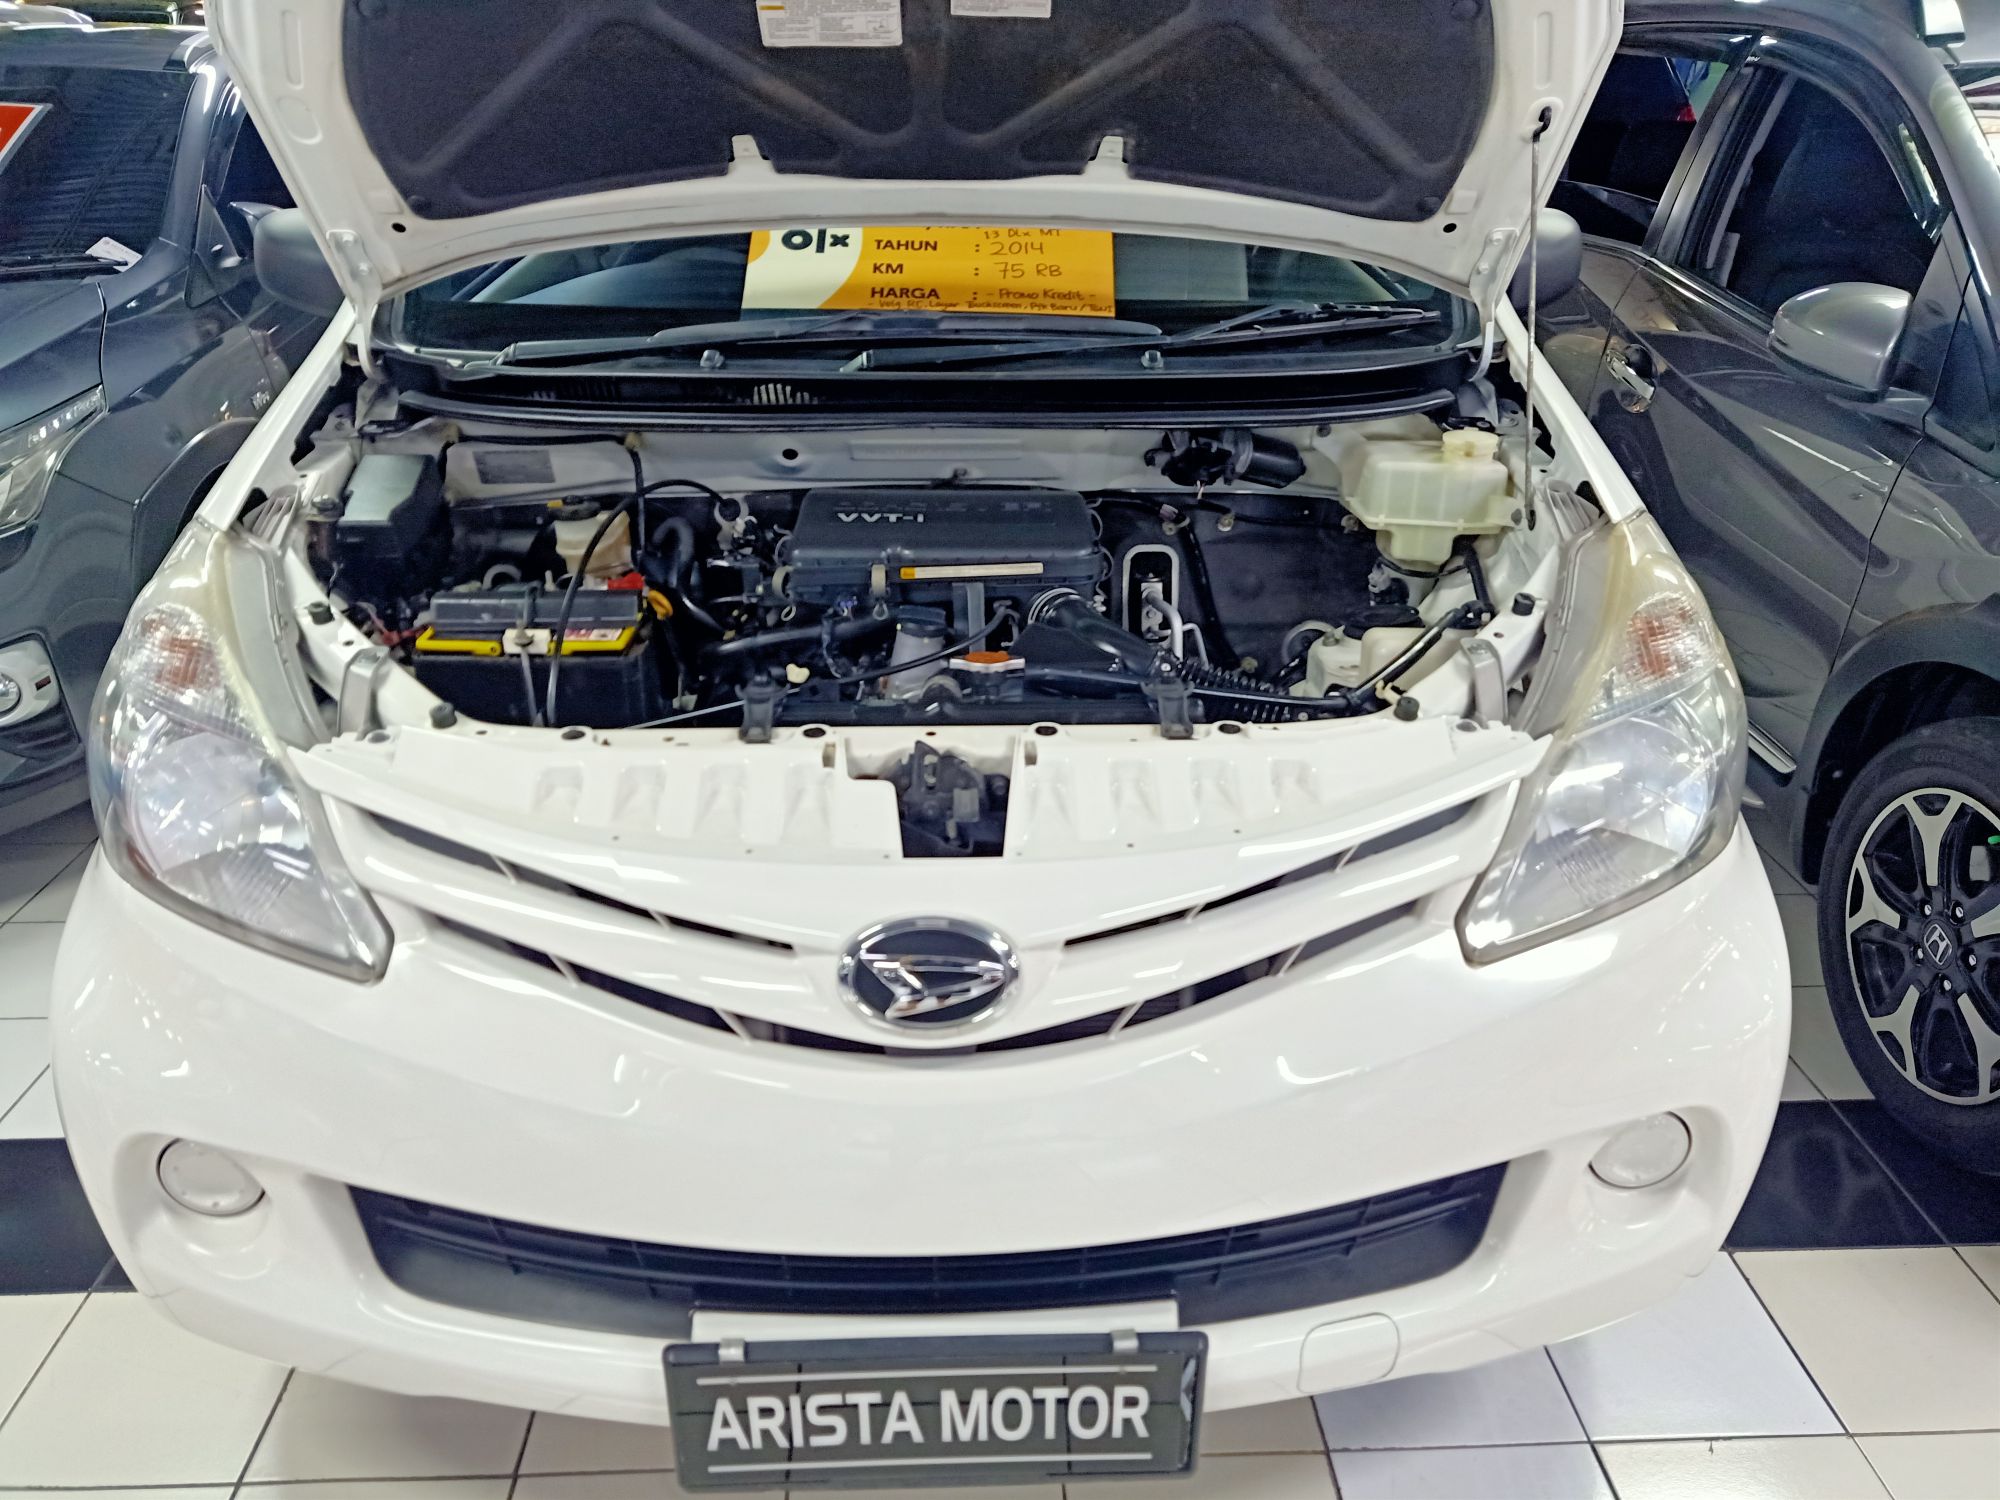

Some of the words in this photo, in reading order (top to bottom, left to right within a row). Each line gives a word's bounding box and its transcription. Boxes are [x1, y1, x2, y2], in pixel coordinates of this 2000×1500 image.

[874, 239, 938, 251] TAHUN
[989, 241, 1044, 256] 2014
[872, 263, 904, 274] KM
[993, 262, 1025, 279] 75
[1035, 263, 1063, 277] RB
[870, 287, 940, 299] HARGA
[706, 1390, 925, 1452] ARISTA
[940, 1384, 1150, 1444] MOTOR
